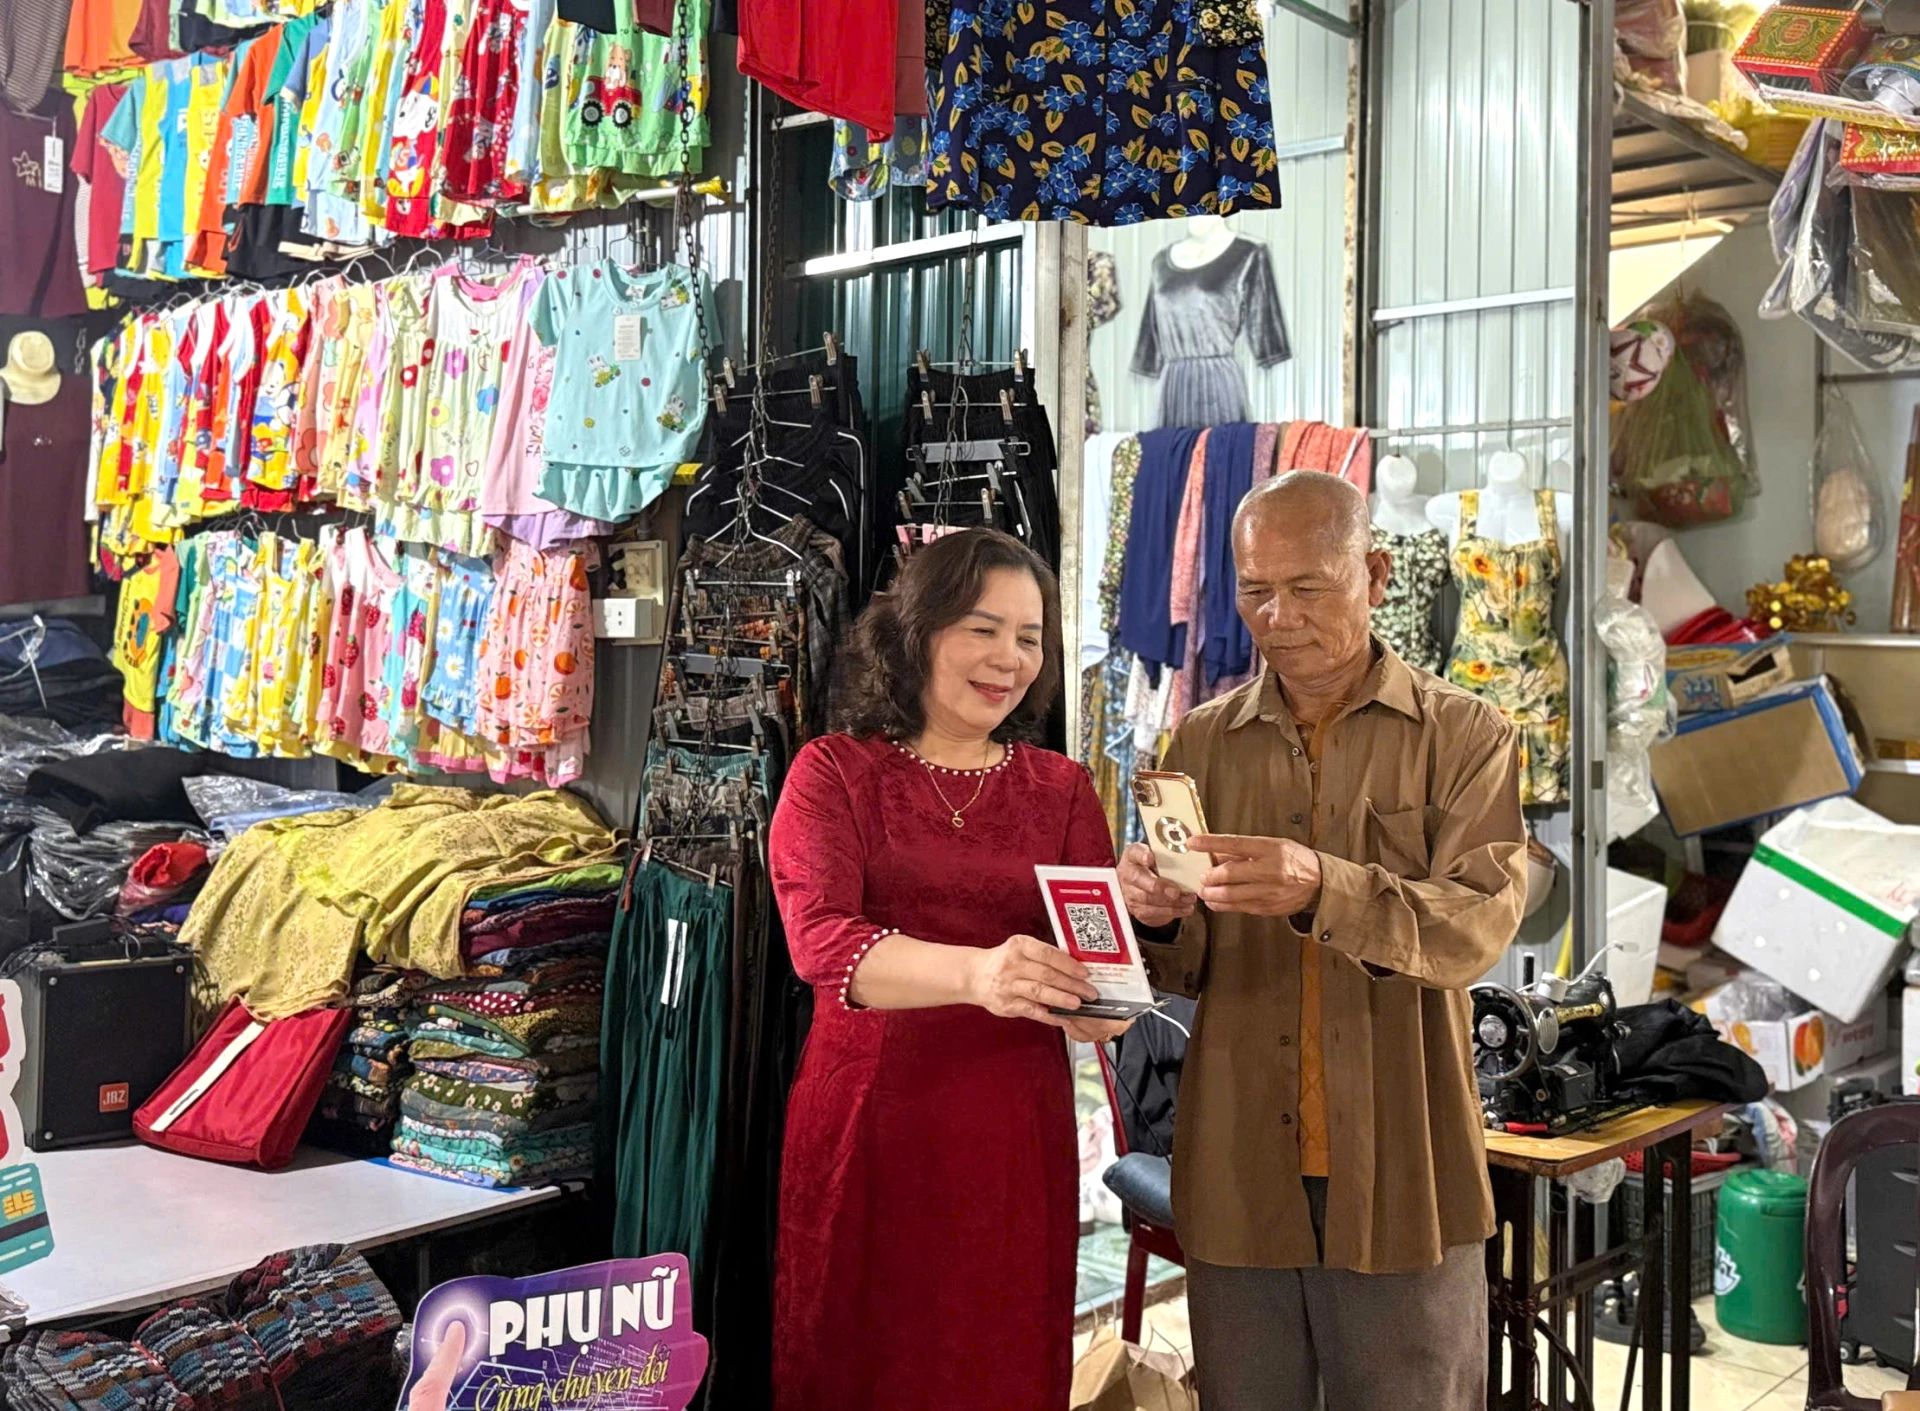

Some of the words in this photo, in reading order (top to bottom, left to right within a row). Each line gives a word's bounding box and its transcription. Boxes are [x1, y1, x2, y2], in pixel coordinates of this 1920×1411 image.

[102, 1090, 126, 1105] JBZ
[489, 1288, 602, 1356] PHỤ
[612, 1266, 680, 1338] NỮ
[475, 1375, 545, 1411] Cùng
[638, 1340, 671, 1387] đổi
